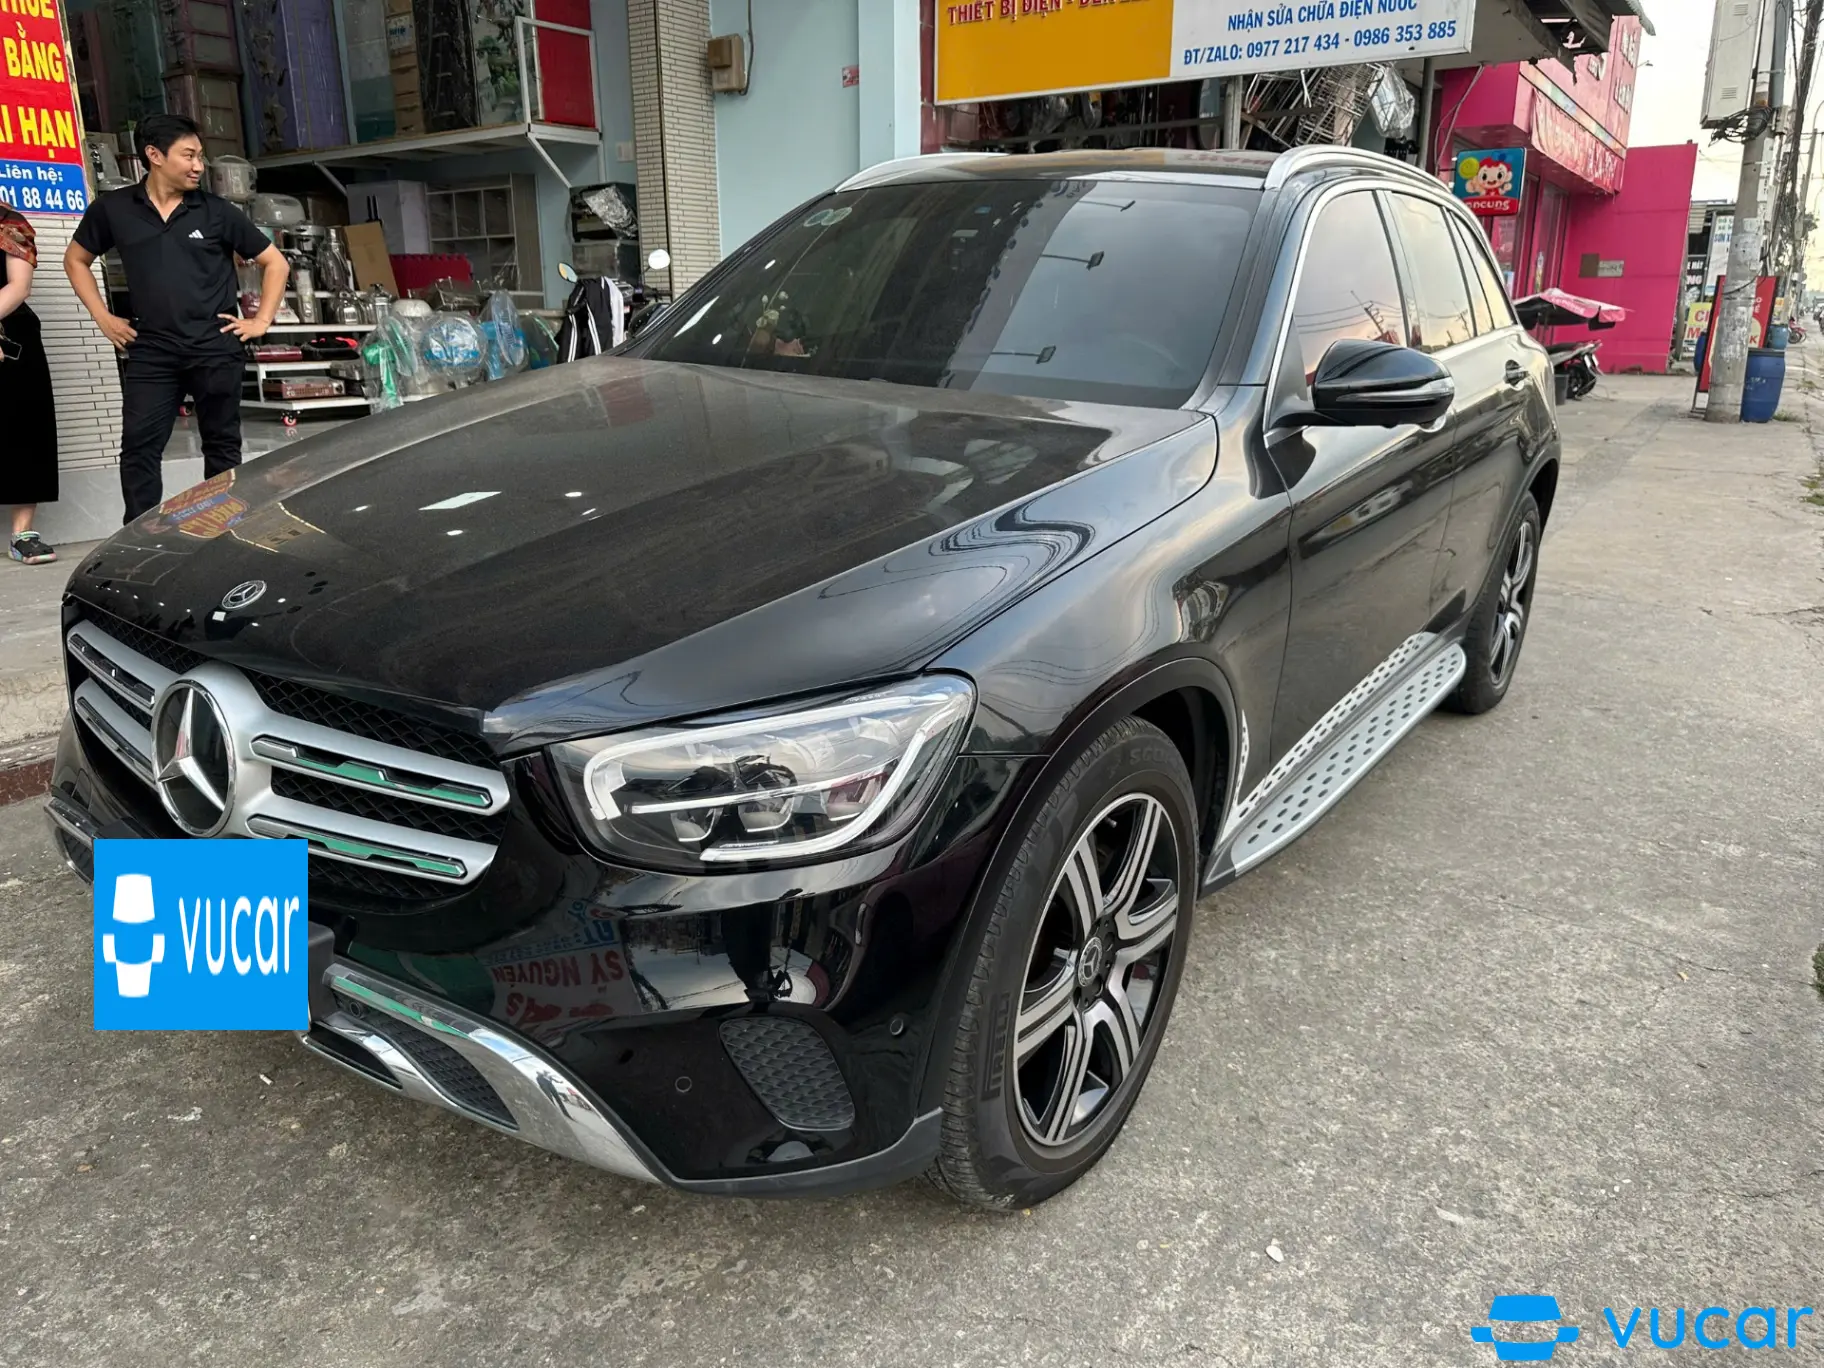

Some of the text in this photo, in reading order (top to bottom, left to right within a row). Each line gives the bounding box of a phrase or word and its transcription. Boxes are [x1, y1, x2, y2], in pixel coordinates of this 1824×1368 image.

[1000, 0, 1017, 22] BỊ
[1228, 9, 1263, 33] NHẬN
[1267, 3, 1293, 26] SỬA
[1298, 0, 1335, 23] CHỮA
[3, 21, 65, 83] BẰNG
[1184, 44, 1242, 65] ĐT/ZALO:
[1246, 40, 1280, 58] 0977
[1283, 36, 1309, 55] 217
[1314, 32, 1340, 51] 434
[1354, 27, 1390, 47] 0986
[1395, 23, 1423, 43] 353
[1427, 20, 1456, 39] 885
[17, 106, 76, 159] HẠN
[36, 166, 63, 185] hệ:
[22, 186, 41, 209] 88
[45, 188, 63, 210] 44
[66, 189, 85, 211] 66
